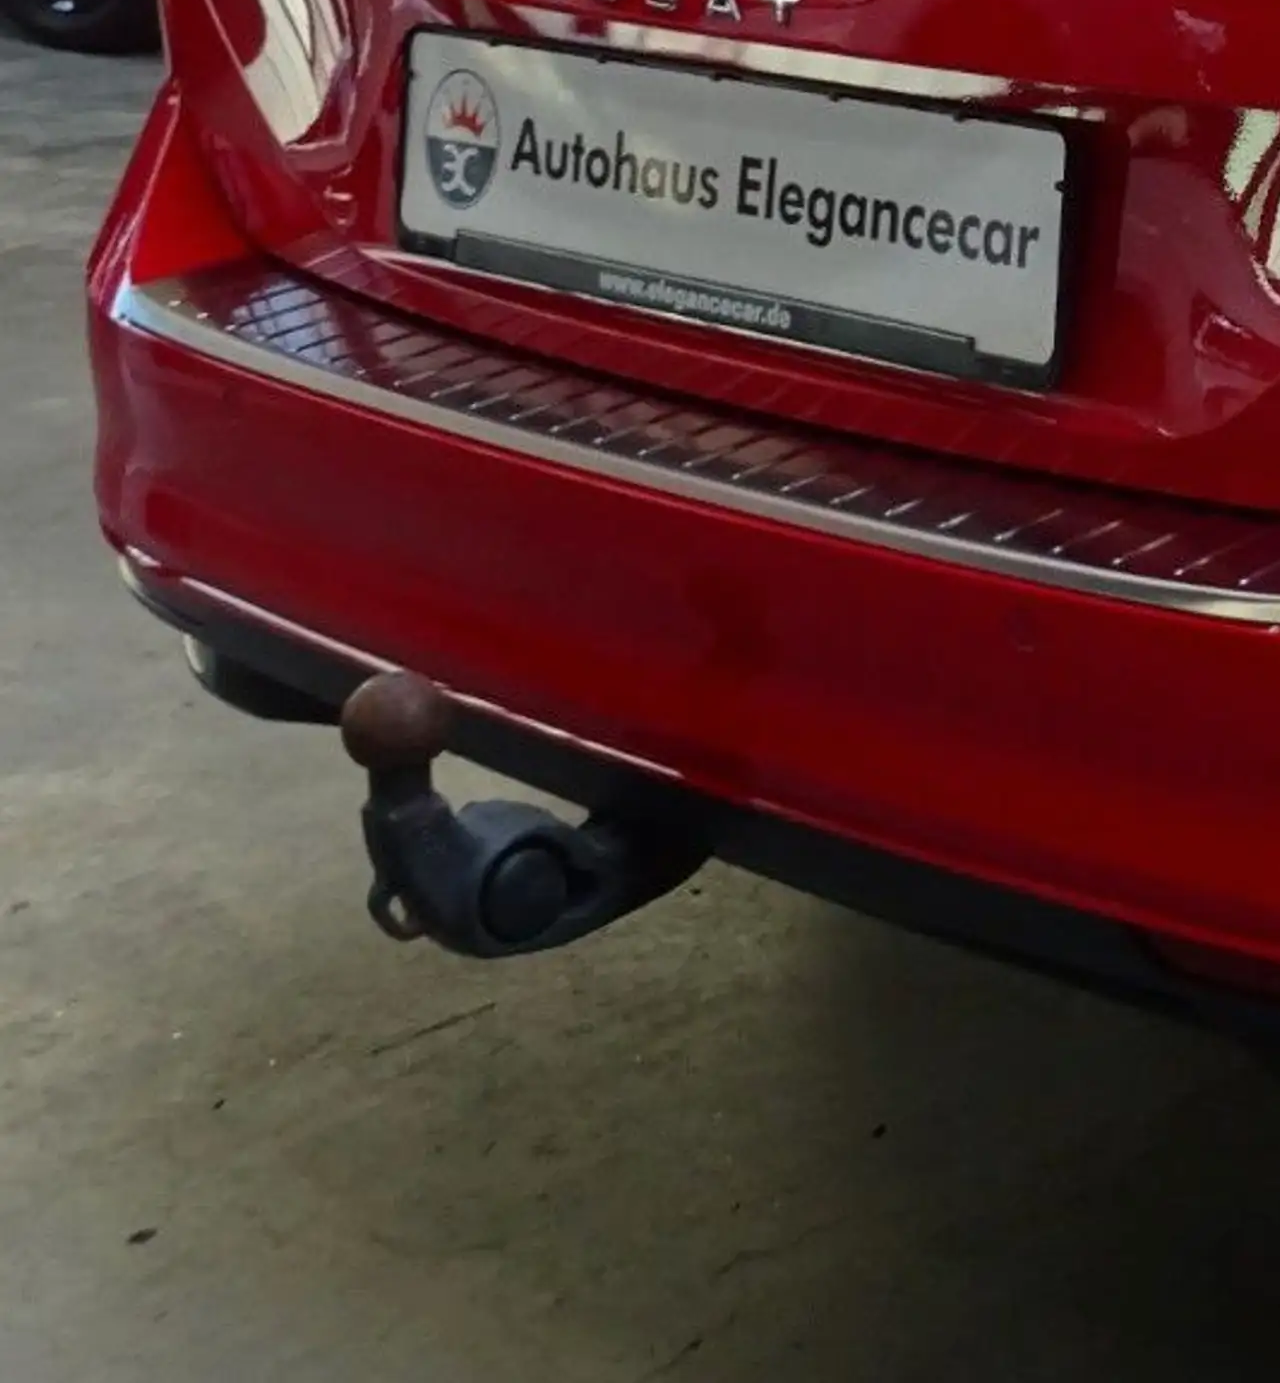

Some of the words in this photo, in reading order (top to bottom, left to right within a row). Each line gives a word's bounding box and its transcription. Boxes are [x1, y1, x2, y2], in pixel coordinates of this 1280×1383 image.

[510, 117, 720, 209] Autohaus
[736, 155, 1040, 268] Elegancecar
[598, 271, 791, 330] www.elegancecar.de
